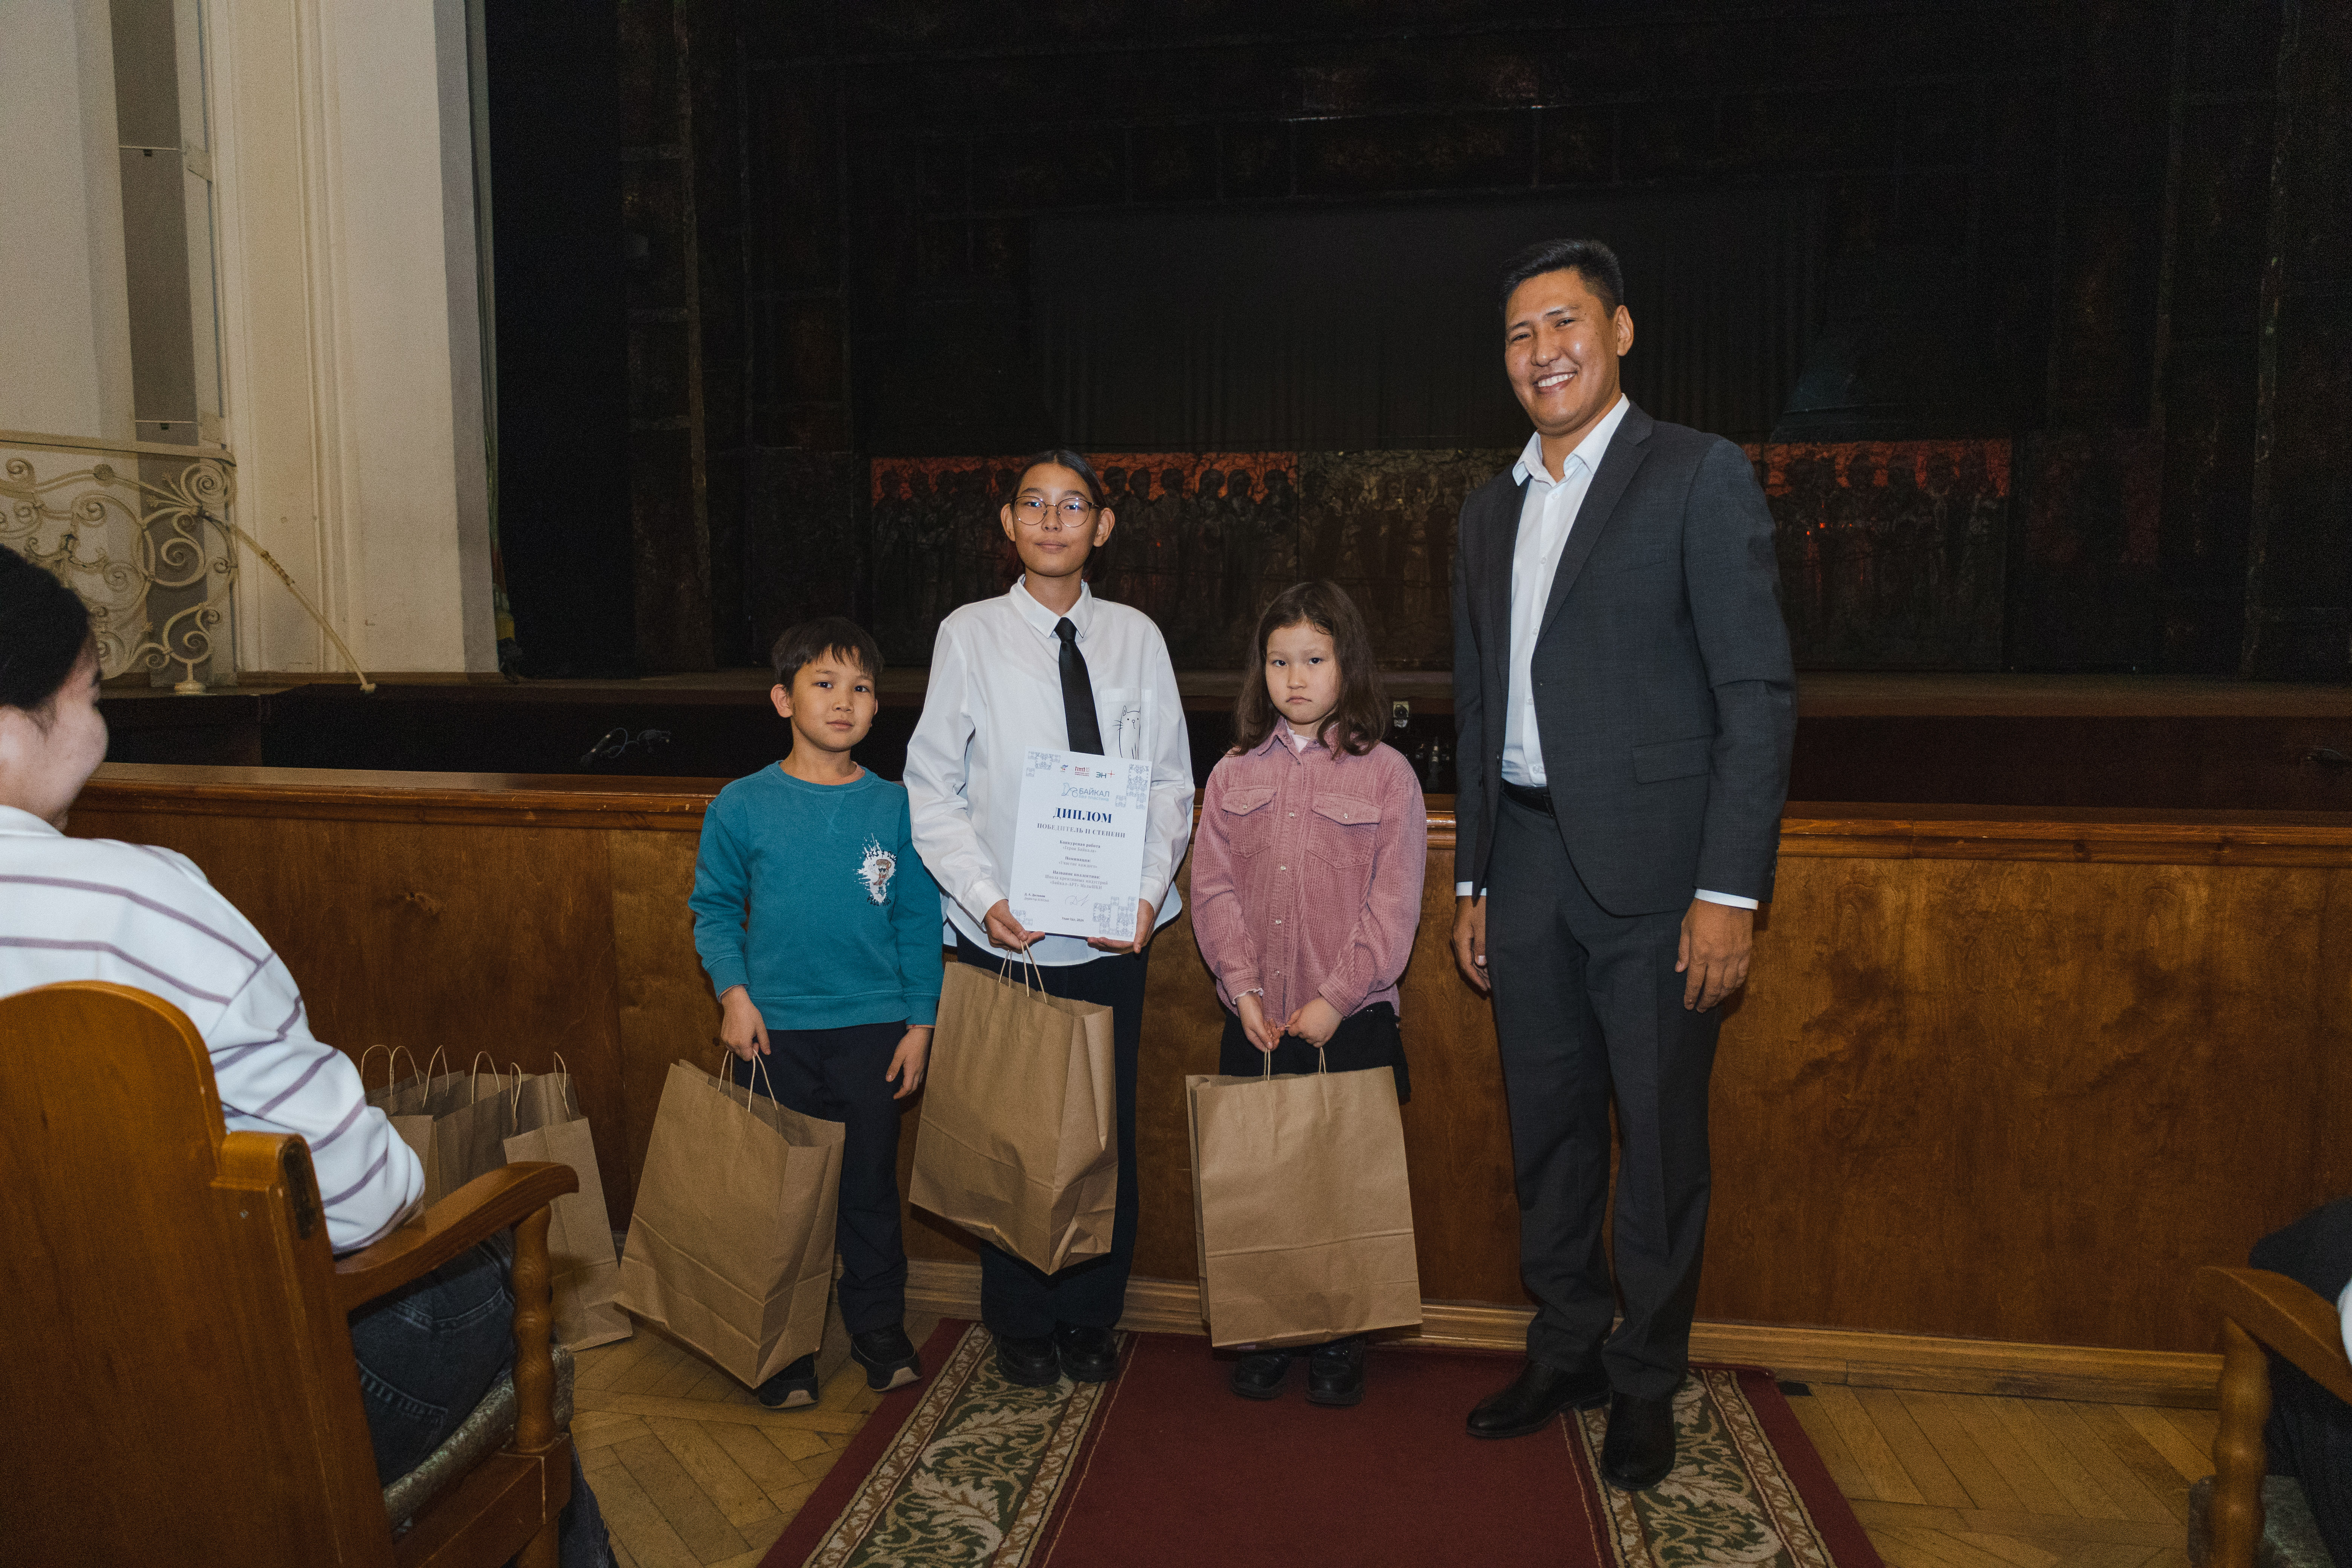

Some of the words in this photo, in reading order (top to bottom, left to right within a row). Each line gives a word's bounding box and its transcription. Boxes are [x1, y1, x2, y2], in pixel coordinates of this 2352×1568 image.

[1079, 787, 1110, 797] БАЙКАЛ
[1052, 807, 1112, 823] ДИПЛОМ
[1037, 822, 1083, 834] ПОБЕДИТЕЛЬ
[1092, 829, 1125, 838] СТЕПЕНИ
[864, 849, 879, 860] TAKE
[881, 849, 885, 858] A
